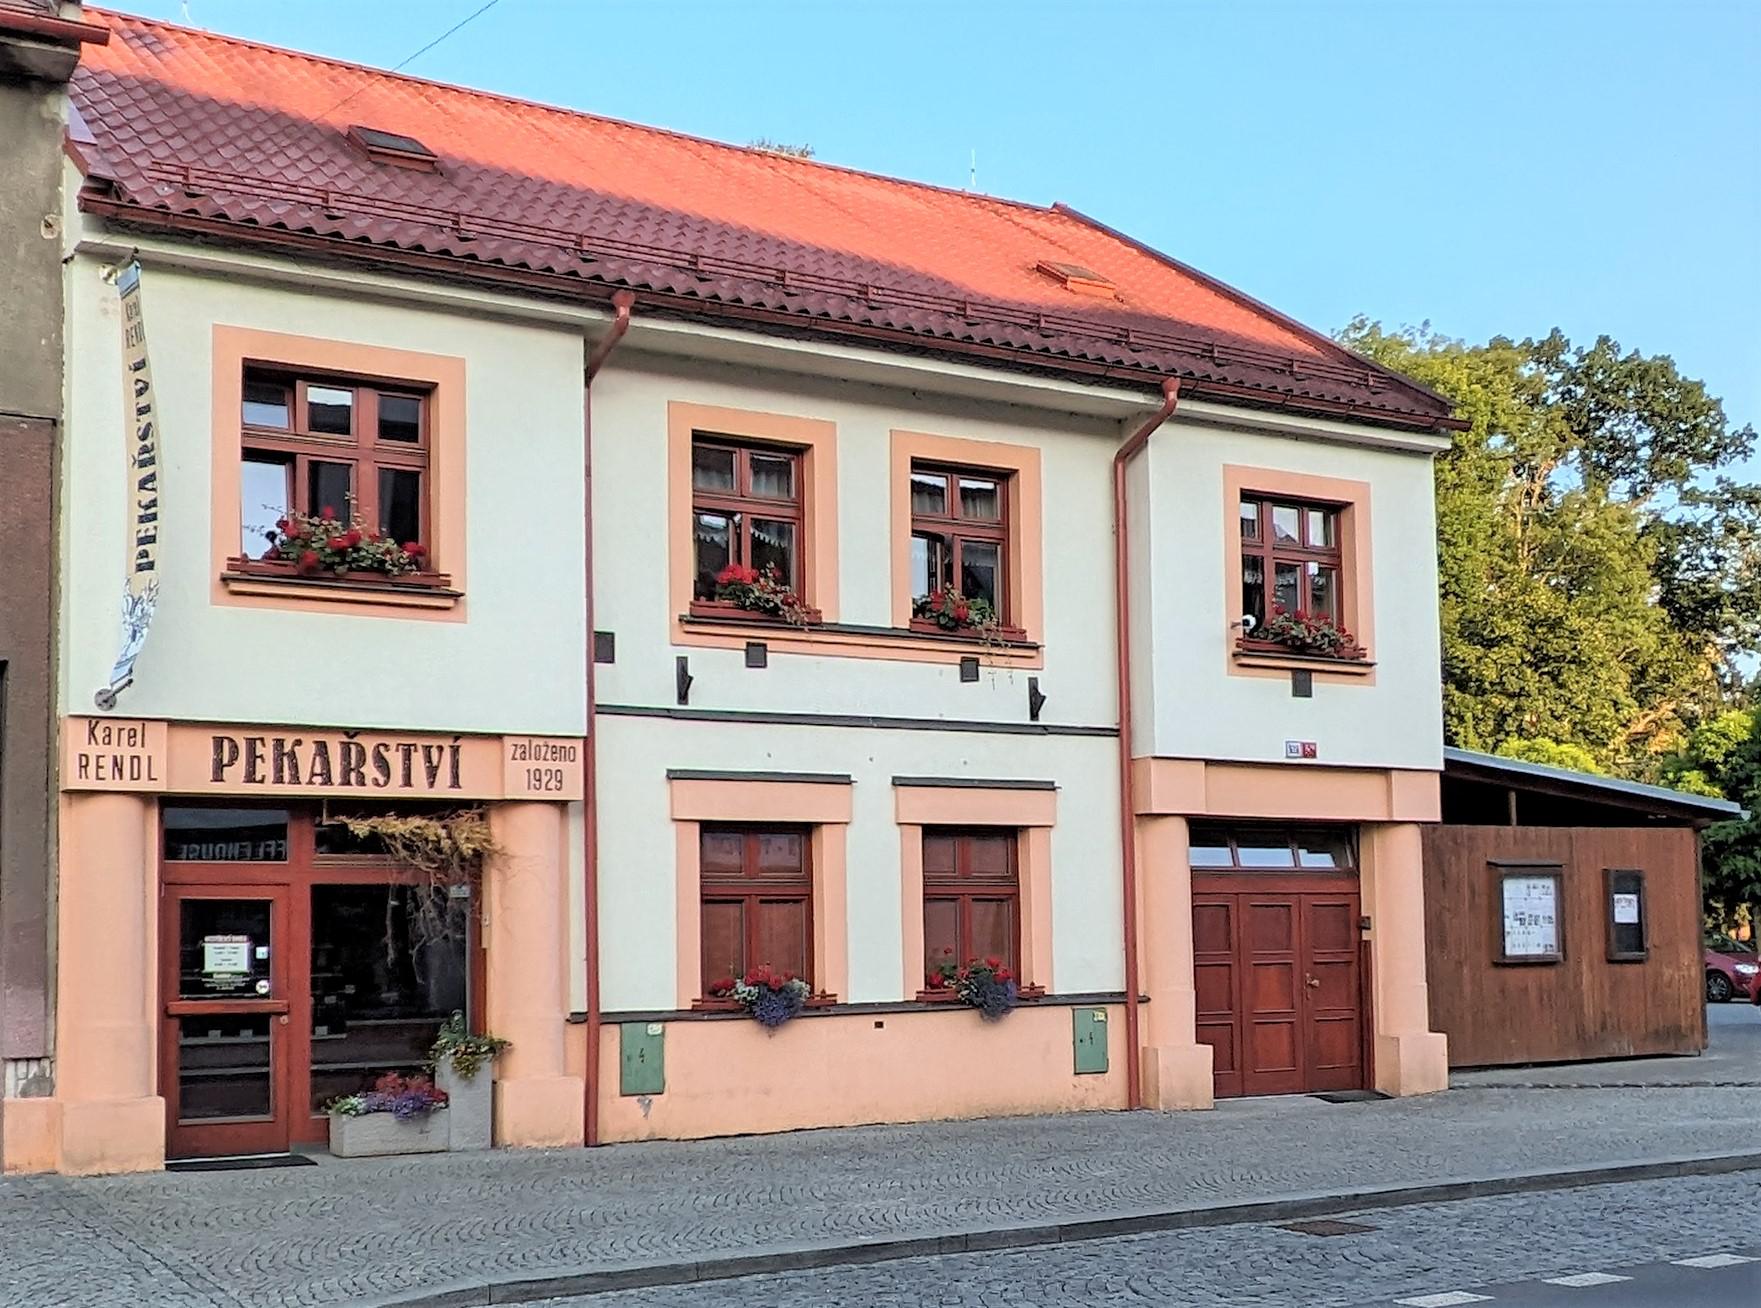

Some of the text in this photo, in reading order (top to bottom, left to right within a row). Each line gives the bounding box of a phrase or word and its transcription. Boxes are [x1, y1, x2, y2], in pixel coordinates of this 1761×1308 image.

[128, 356, 159, 574] PEKAŘSTVÍ
[87, 719, 146, 748] Karel
[210, 731, 463, 789] PEKAŘSTVÍ
[511, 739, 576, 762] založeno
[78, 753, 158, 781] RENDL
[526, 768, 563, 791] 1929
